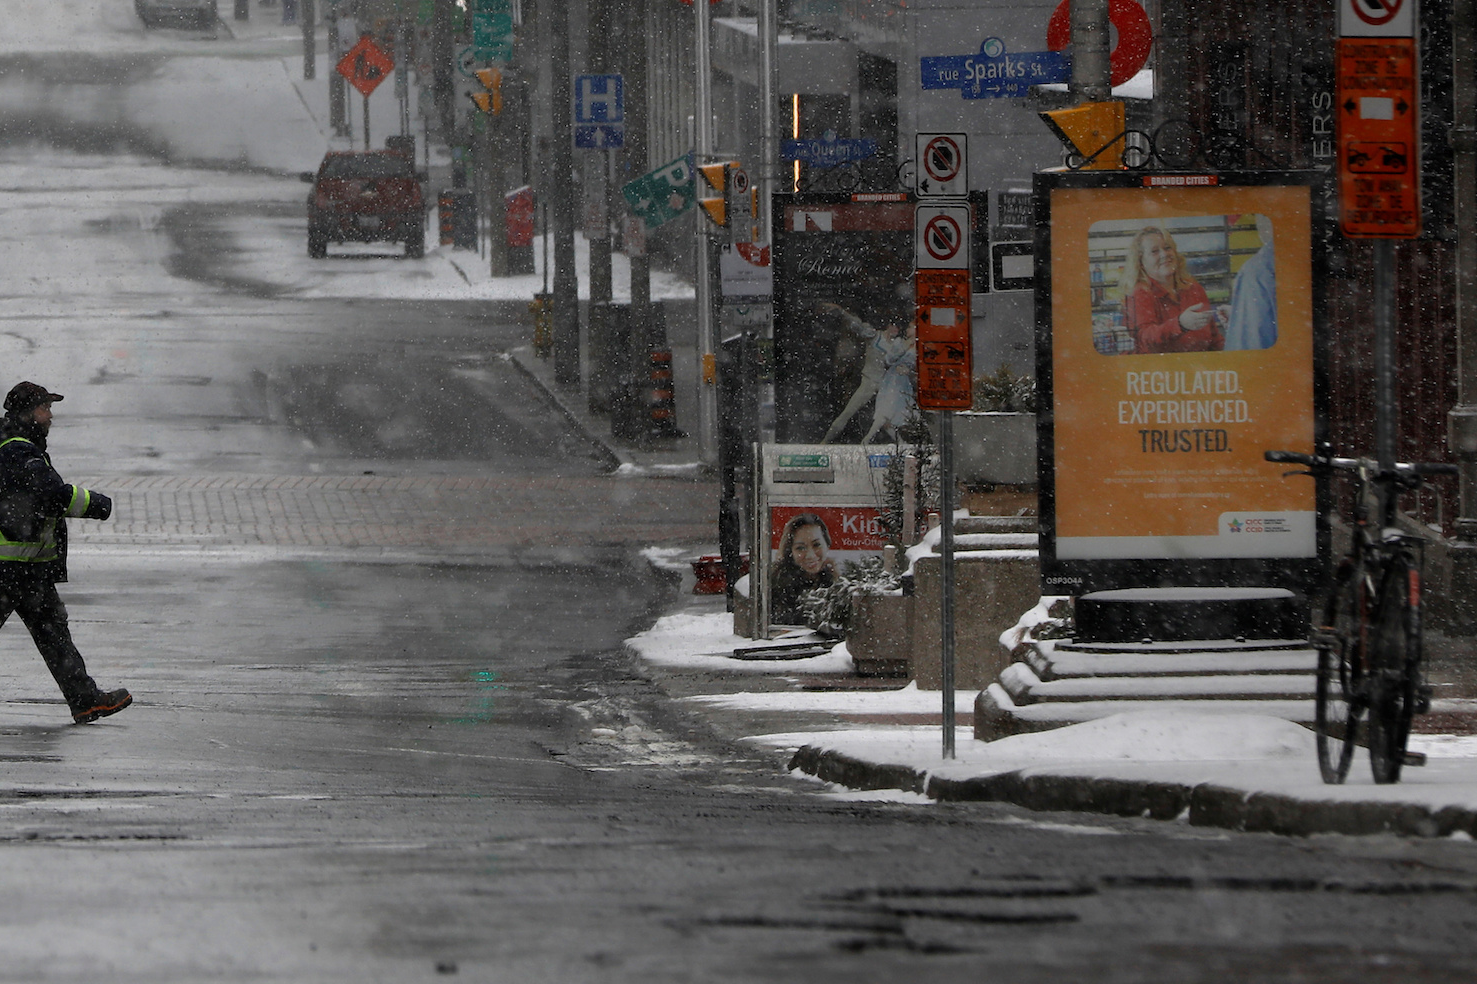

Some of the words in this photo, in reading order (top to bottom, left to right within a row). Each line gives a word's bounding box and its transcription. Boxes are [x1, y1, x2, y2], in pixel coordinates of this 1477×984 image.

[939, 69, 959, 81] rue
[965, 56, 1024, 84] Sparks
[1031, 62, 1046, 76] St.
[811, 142, 850, 159] Queen
[1151, 176, 1185, 186] BRANDED
[1186, 176, 1210, 185] CITIES
[1127, 370, 1244, 395] REGULATED.
[1118, 399, 1253, 424] EXPERIENCED.
[1139, 429, 1233, 453] TRUSTED.
[1045, 576, 1083, 585] OSP304A
